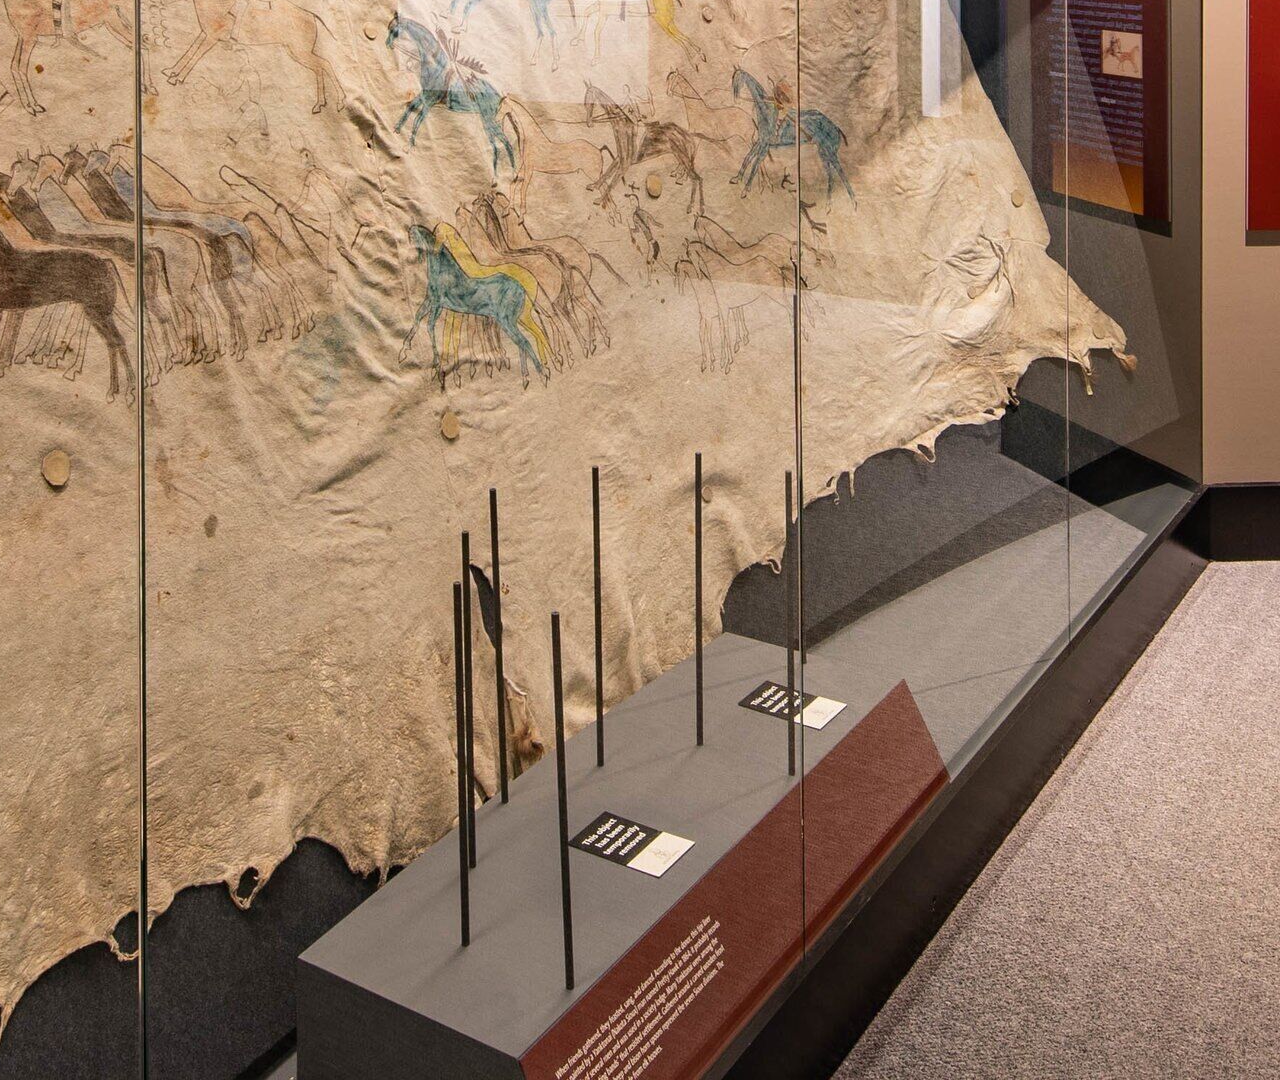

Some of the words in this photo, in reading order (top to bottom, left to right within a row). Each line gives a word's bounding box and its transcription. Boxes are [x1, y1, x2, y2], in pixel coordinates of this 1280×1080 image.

[582, 834, 599, 846] This
[596, 818, 617, 835] object
[595, 837, 610, 848] has
[606, 824, 625, 839] been
[603, 825, 640, 855] temporarily
[619, 832, 647, 856] removed
